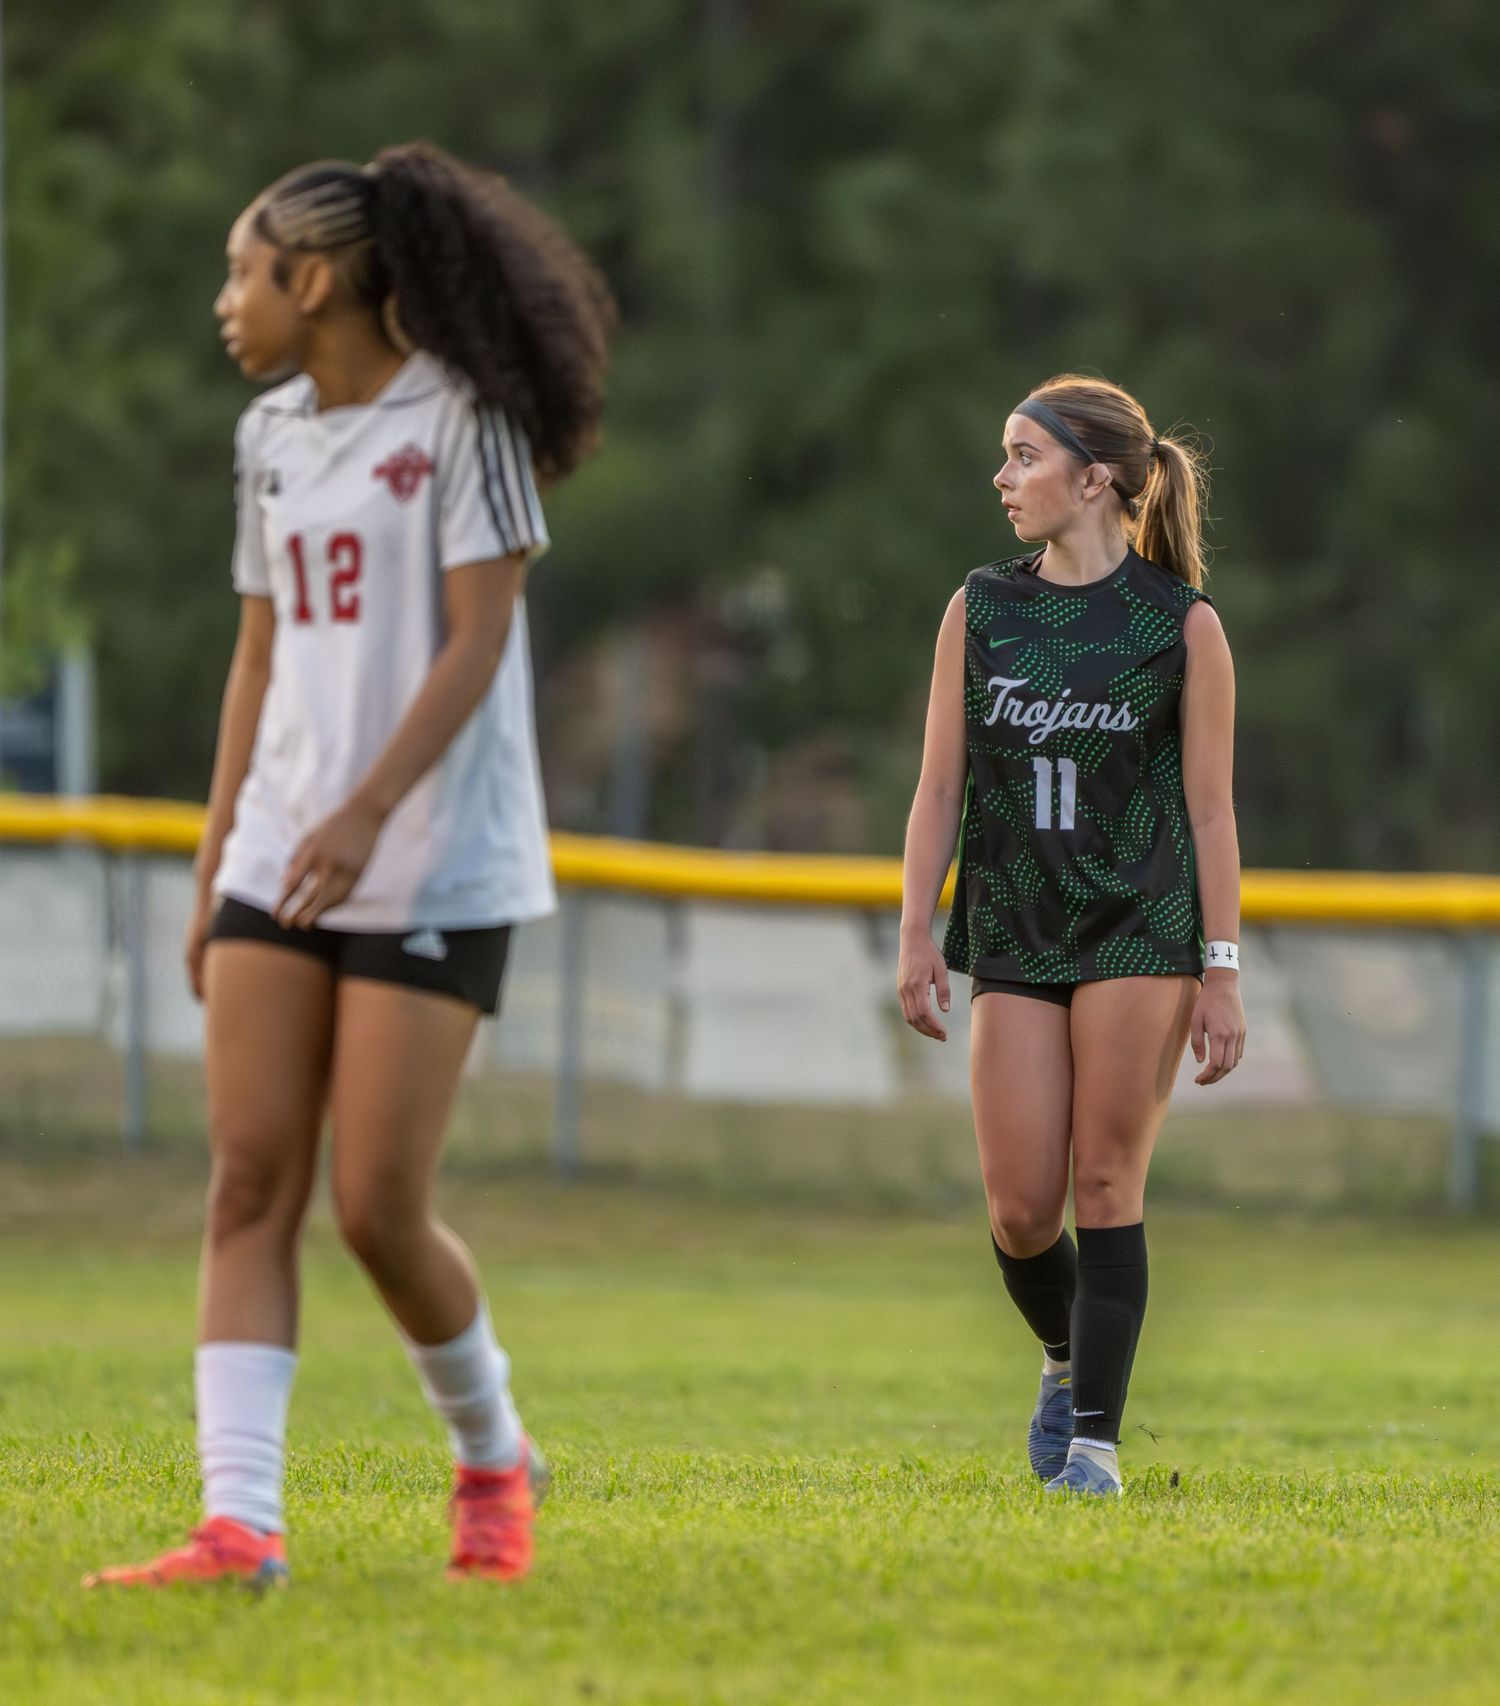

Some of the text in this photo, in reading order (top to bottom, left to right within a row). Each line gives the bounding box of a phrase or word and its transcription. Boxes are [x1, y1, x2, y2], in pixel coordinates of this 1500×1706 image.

[286, 532, 363, 625] 12
[984, 676, 1139, 745] Trojans
[1033, 756, 1077, 830] 11
